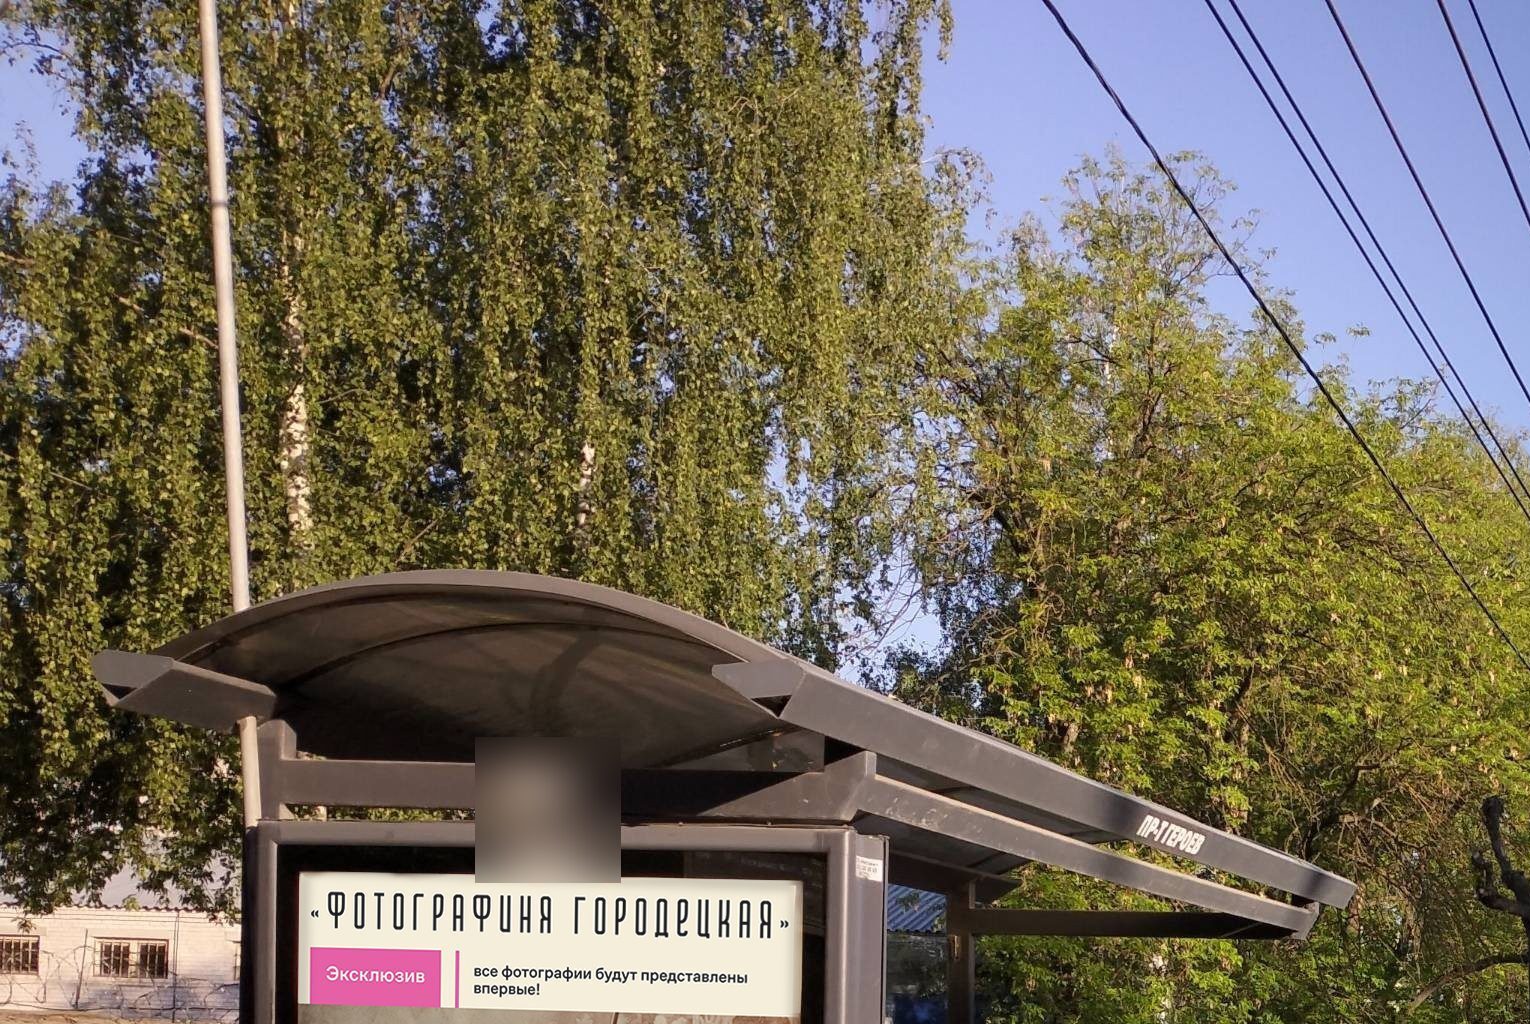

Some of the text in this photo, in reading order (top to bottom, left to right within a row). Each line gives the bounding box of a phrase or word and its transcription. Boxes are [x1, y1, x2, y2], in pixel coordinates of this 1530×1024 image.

[1160, 822, 1206, 855] ГЕРОЕВ
[326, 965, 425, 983] Эксклюзив
[473, 964, 748, 985] все фотографии будут представлены
[473, 982, 540, 998] впервые!
